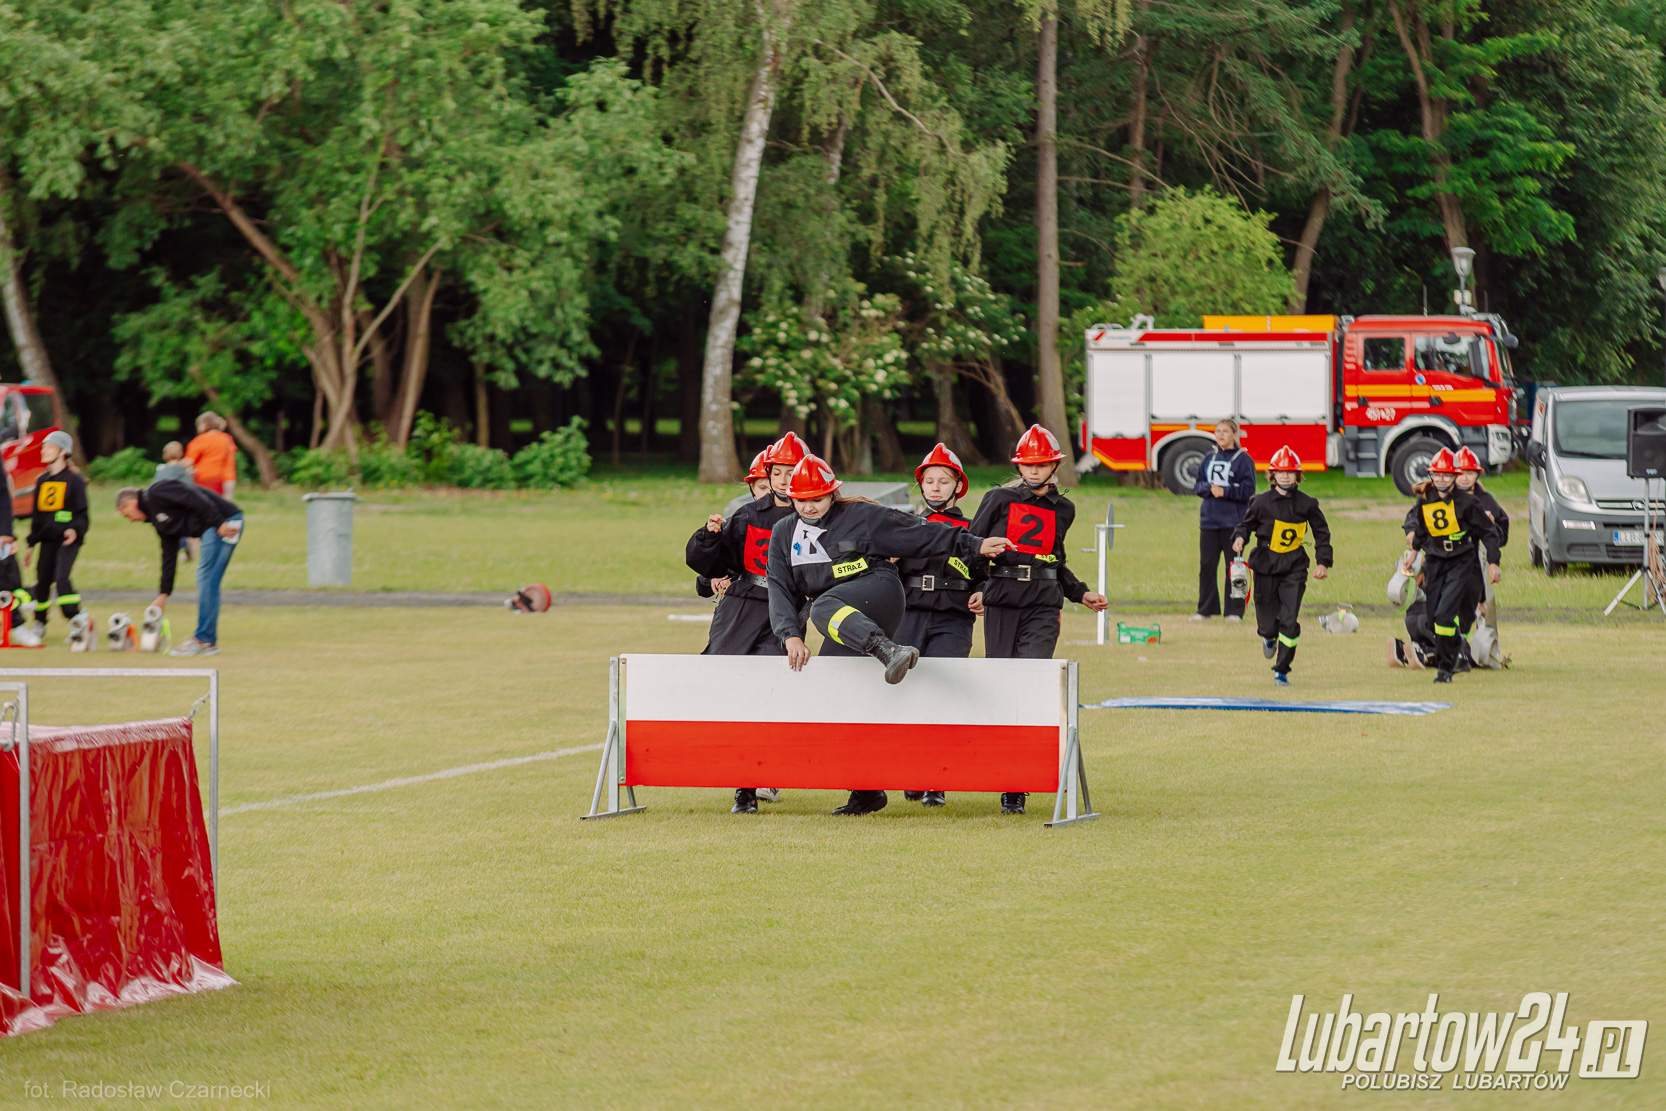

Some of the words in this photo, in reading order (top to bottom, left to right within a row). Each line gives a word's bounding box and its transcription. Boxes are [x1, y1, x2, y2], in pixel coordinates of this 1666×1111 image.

[1211, 464, 1226, 481] R
[1432, 508, 1449, 529] 8
[1017, 514, 1044, 547] 2
[1280, 529, 1297, 547] 9
